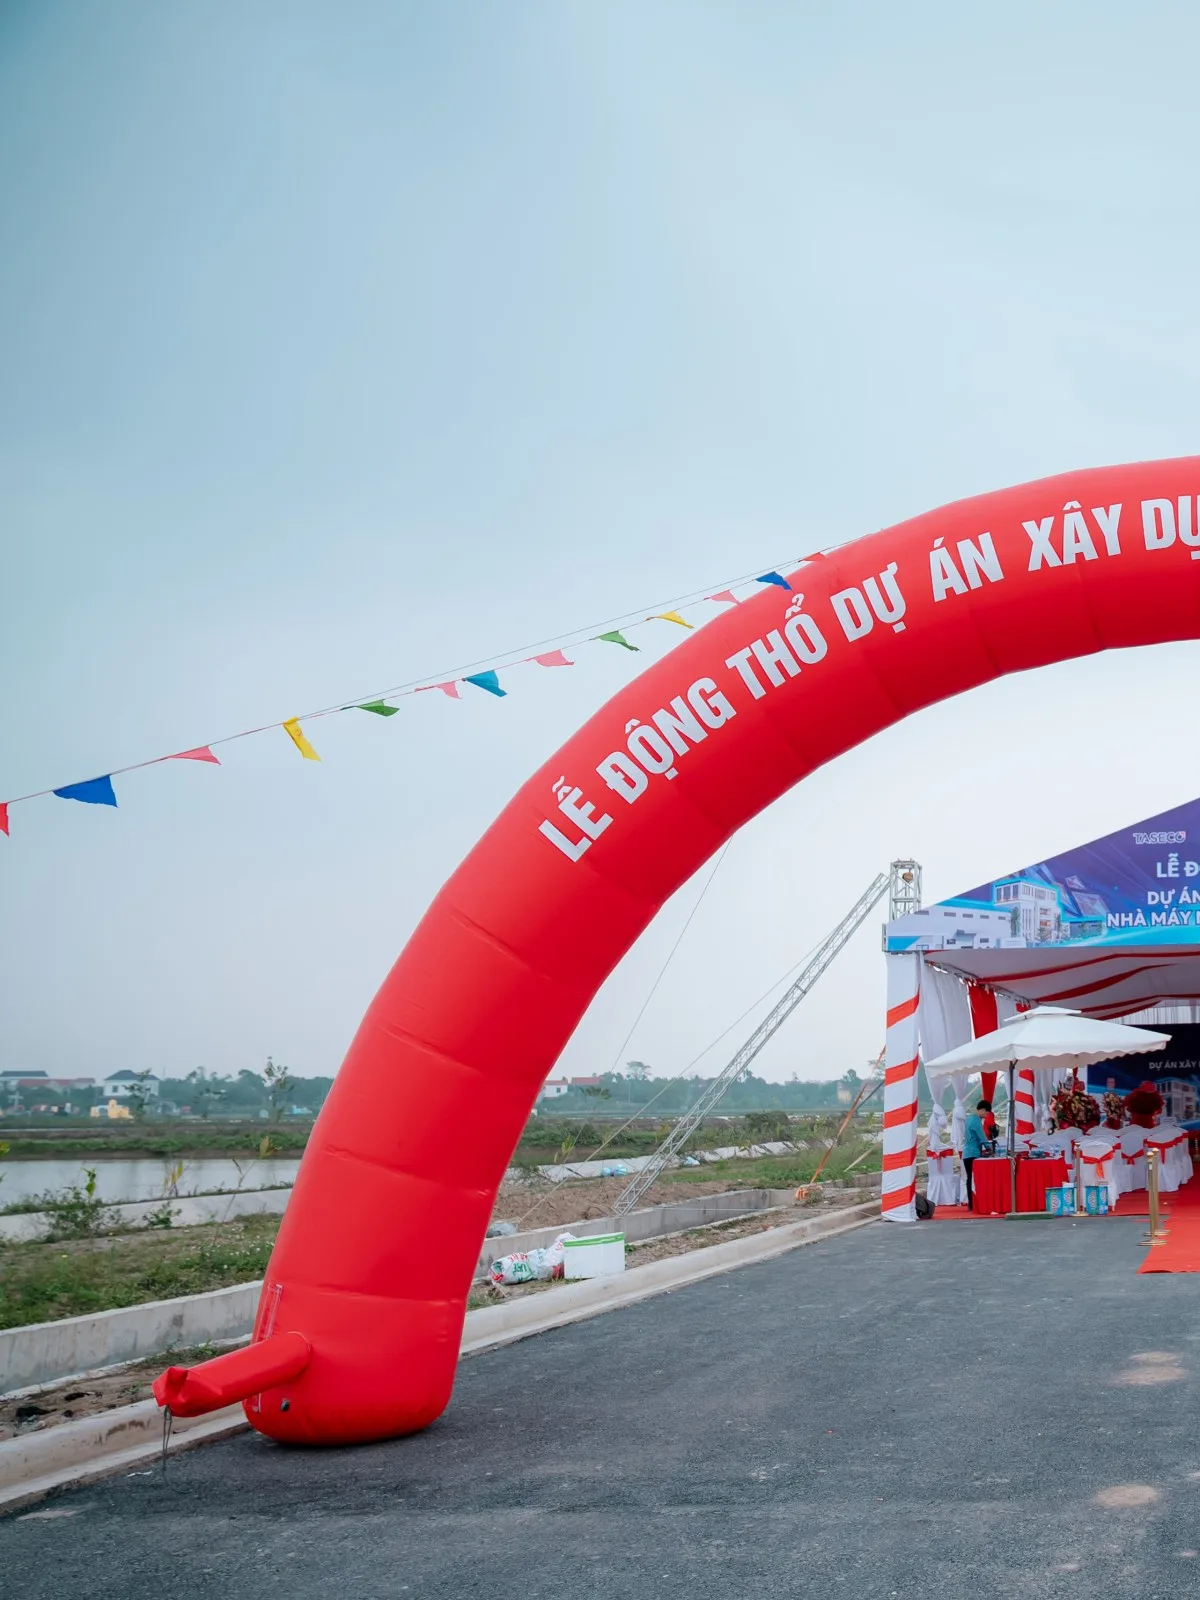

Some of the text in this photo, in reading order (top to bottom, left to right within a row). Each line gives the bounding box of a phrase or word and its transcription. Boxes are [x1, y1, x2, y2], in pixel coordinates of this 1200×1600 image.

[538, 775, 613, 863] LỄ
[595, 677, 738, 804] ĐỘNG
[724, 592, 829, 701] THỔ
[829, 561, 908, 643] DỰ
[929, 532, 1005, 603] ÁN
[1021, 500, 1124, 572] XÂY
[1132, 830, 1187, 845] TASECO
[1156, 852, 1180, 878] LỄ
[1147, 889, 1175, 909] DỰ
[1107, 909, 1149, 928] NHÀ
[1151, 907, 1192, 926] MÁY
[1149, 1061, 1163, 1071] DỰ
[1164, 1059, 1178, 1070] ÁN
